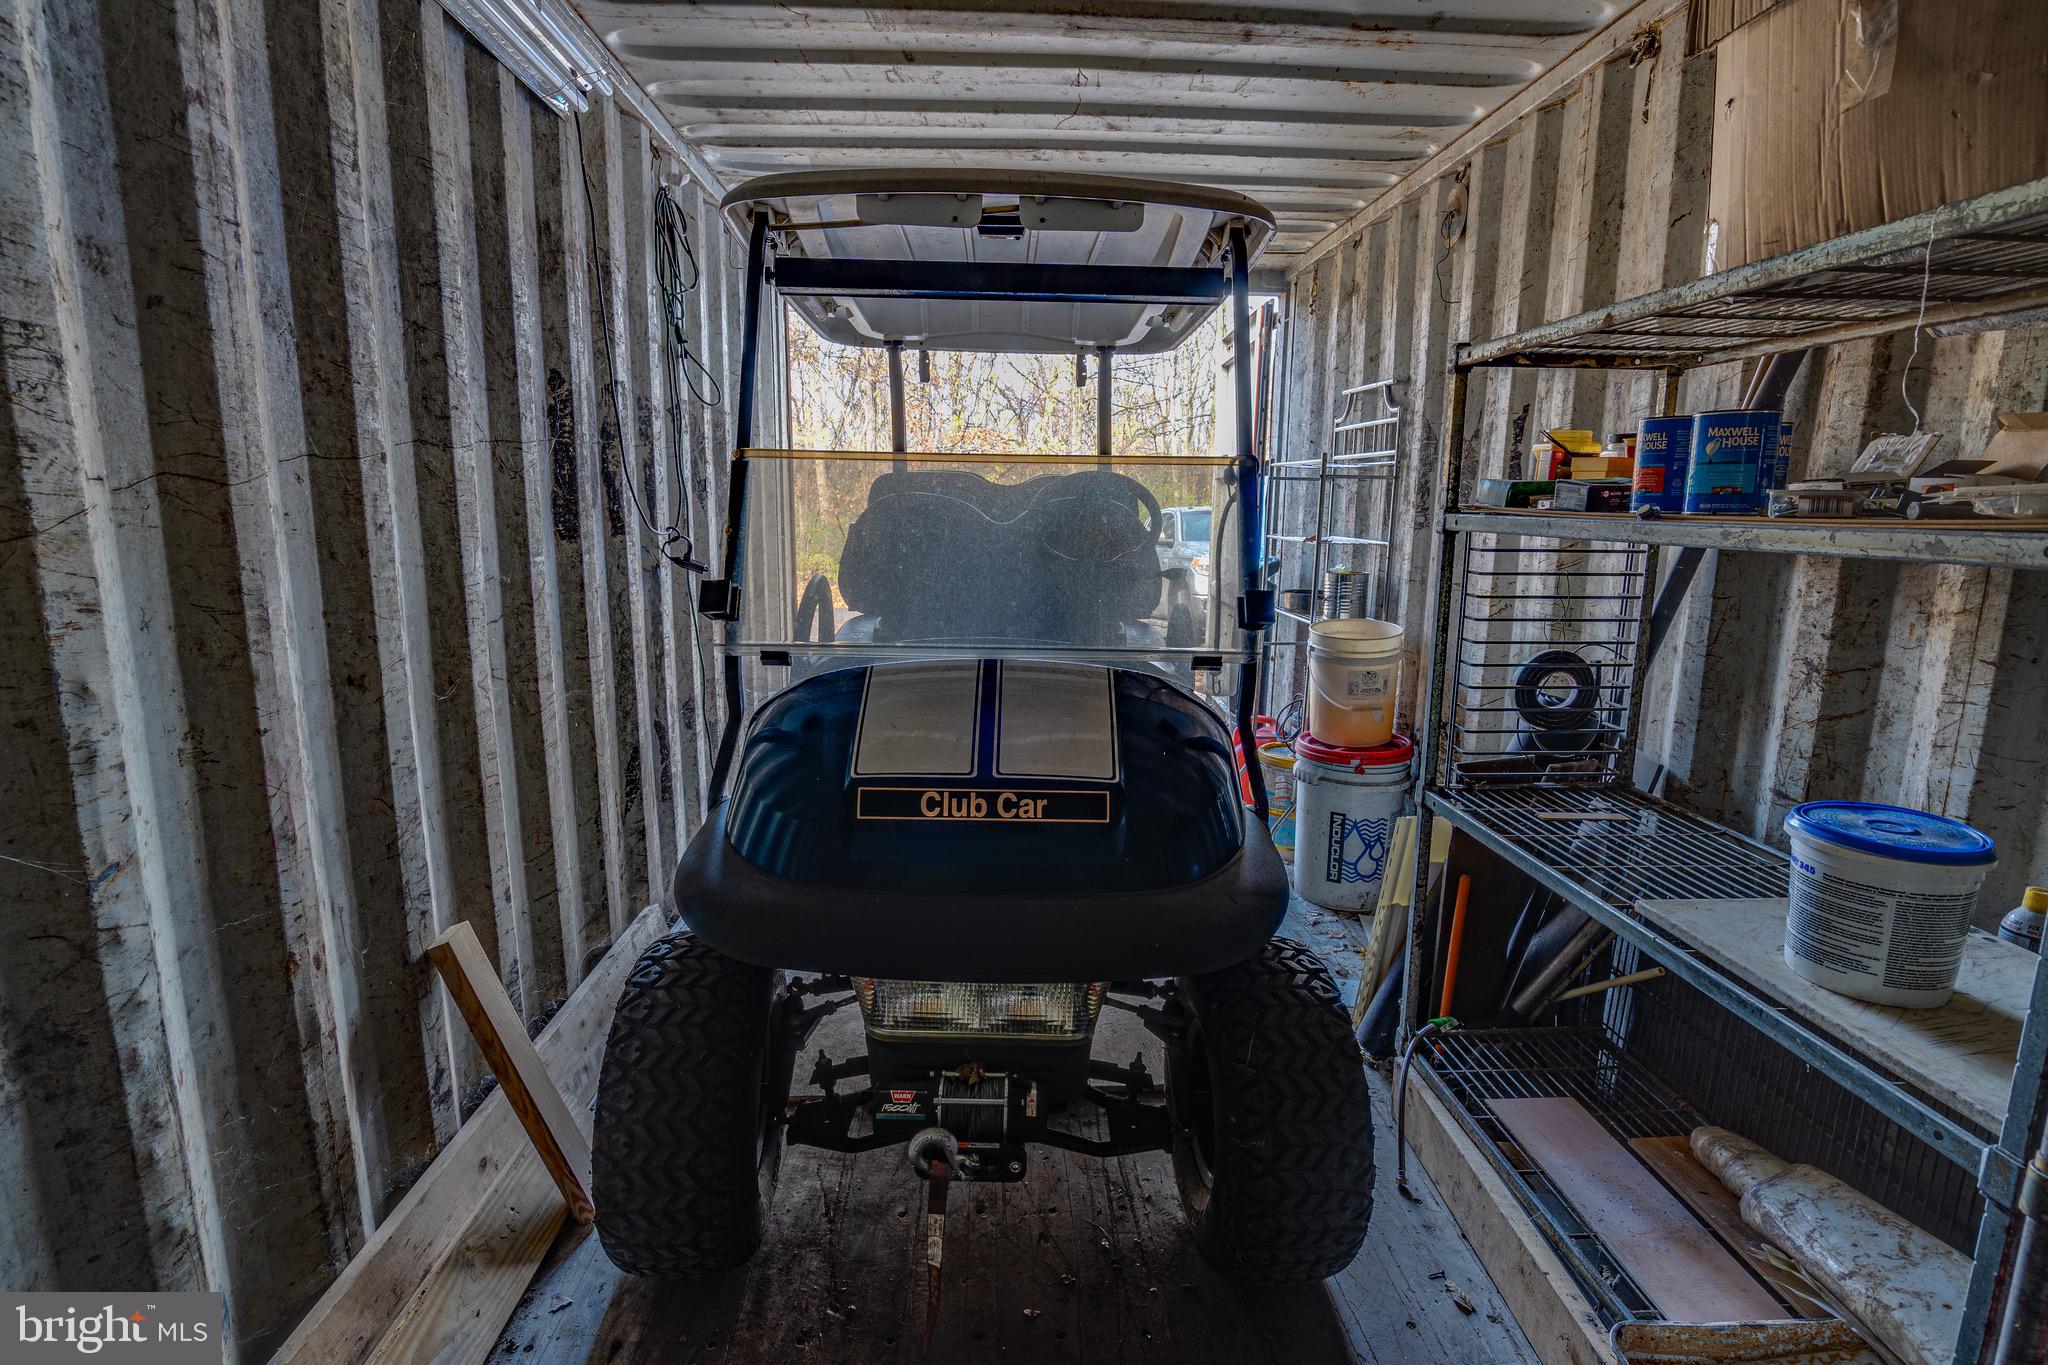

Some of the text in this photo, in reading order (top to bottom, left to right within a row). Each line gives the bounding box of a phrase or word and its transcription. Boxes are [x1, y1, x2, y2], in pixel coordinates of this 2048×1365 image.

[1708, 426, 1760, 438] MAXWELL
[1722, 436, 1760, 448] HOUSE
[920, 791, 1048, 819] Club Car
[1329, 814, 1344, 880] INDUCLOR
